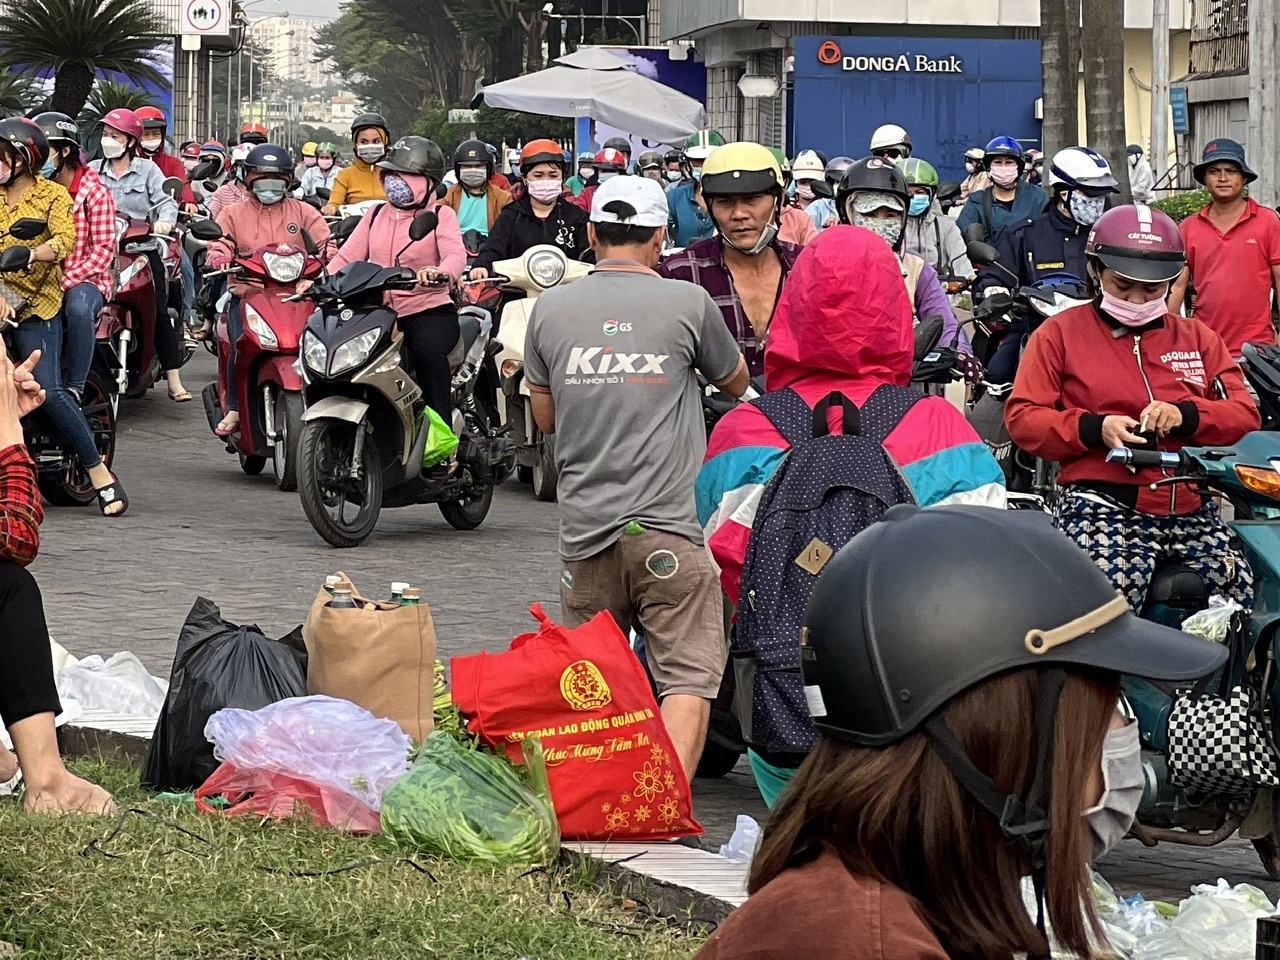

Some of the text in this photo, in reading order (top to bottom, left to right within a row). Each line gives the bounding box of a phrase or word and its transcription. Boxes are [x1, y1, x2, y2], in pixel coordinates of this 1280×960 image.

[914, 54, 962, 73] Bank
[619, 322, 632, 332] GS
[565, 345, 669, 375] Kixx
[558, 724, 579, 735] LAO
[580, 718, 610, 734] ĐỘNG
